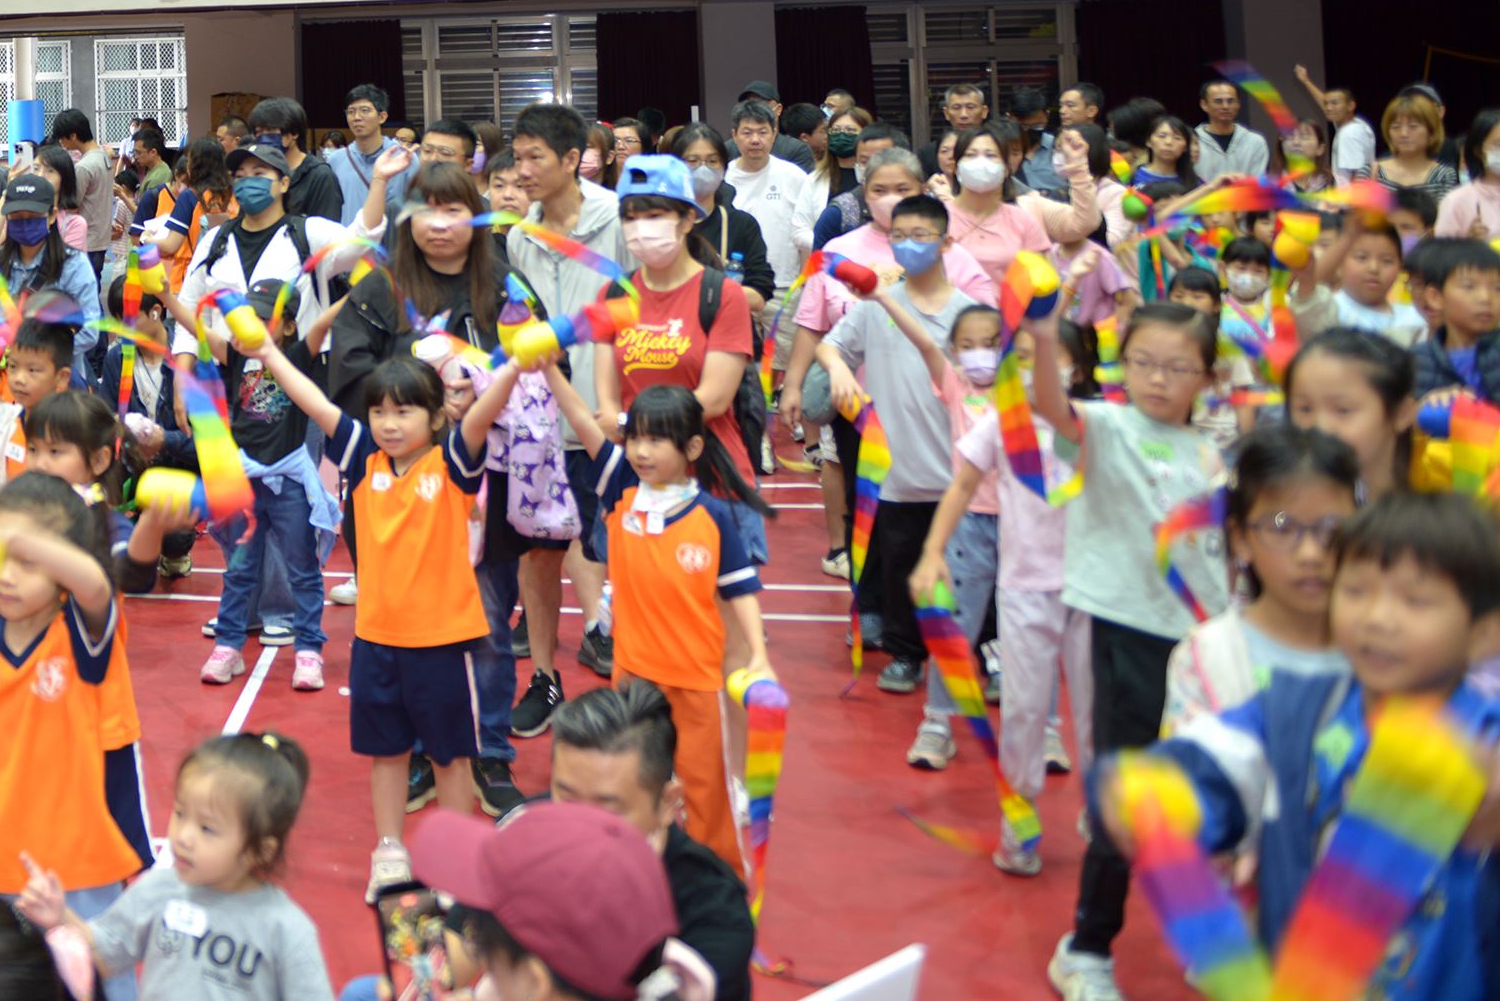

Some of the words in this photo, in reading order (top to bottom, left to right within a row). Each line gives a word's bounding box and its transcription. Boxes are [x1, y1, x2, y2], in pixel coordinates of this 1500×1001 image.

[616, 327, 692, 356] Mickey
[623, 345, 677, 364] Mouse
[192, 928, 263, 976] YOU
